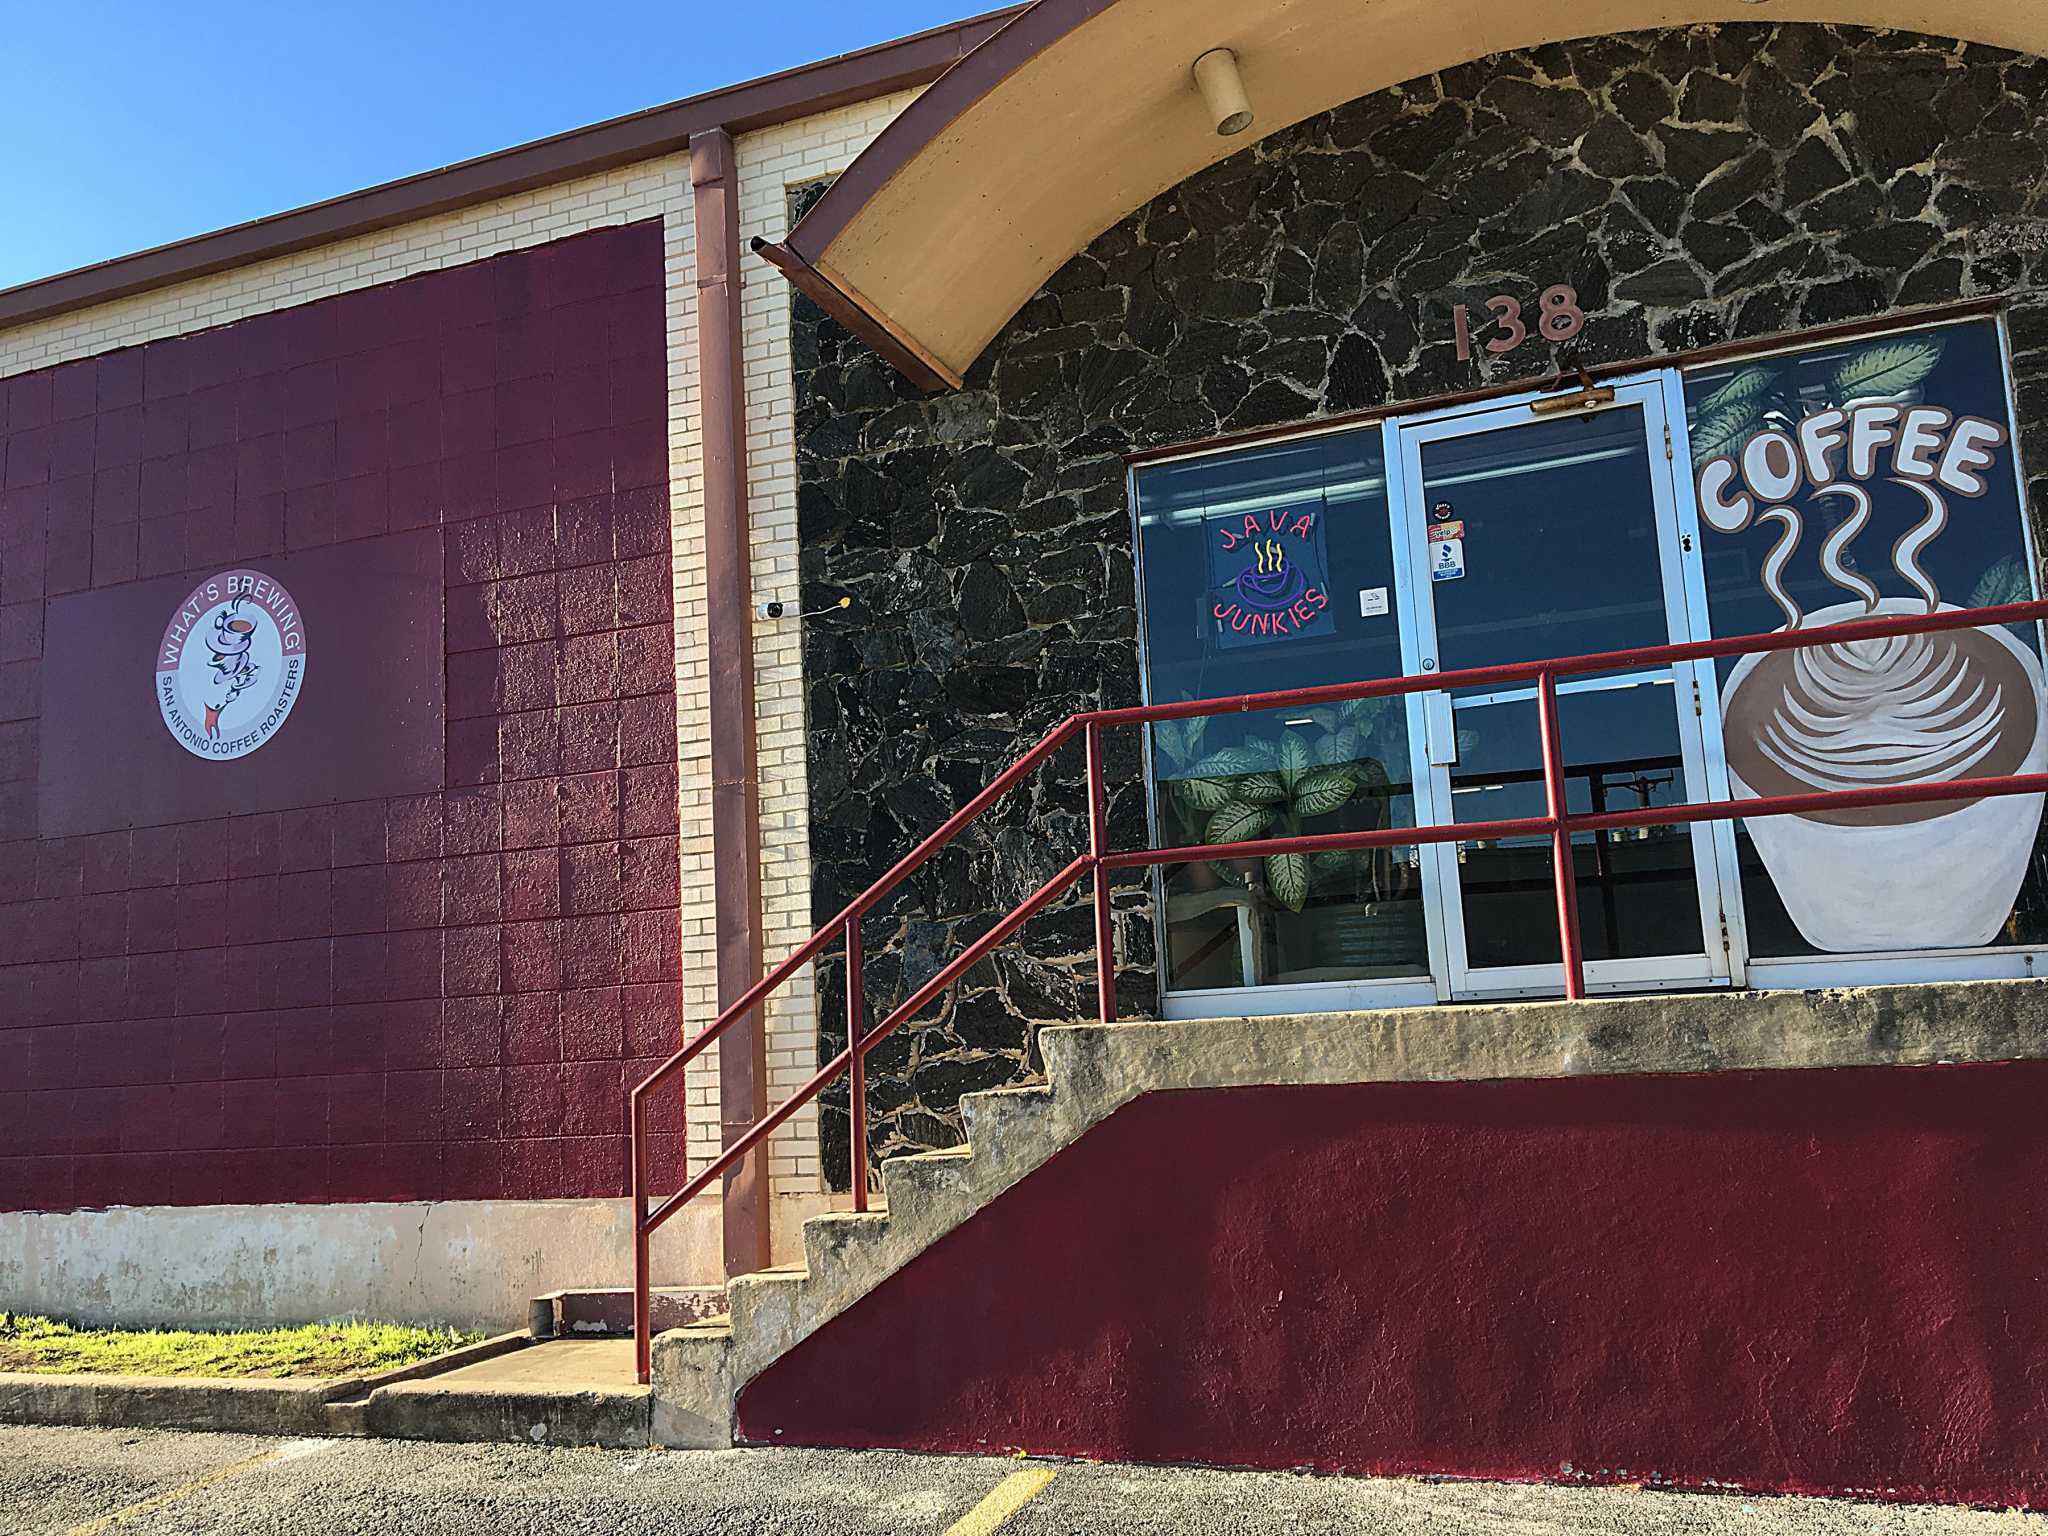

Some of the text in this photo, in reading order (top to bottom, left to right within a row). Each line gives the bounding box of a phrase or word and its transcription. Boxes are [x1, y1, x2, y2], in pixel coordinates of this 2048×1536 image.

[1453, 283, 1585, 361] 138
[1696, 402, 2008, 534] COFFEE
[1219, 510, 1312, 549] JAVA
[1438, 560, 1456, 570] BBB
[163, 575, 300, 665] WHAT'S BREWING
[1213, 588, 1328, 635] JUNKIES
[163, 659, 299, 754] SAN ANTONIO COFFEE ROASTERS
